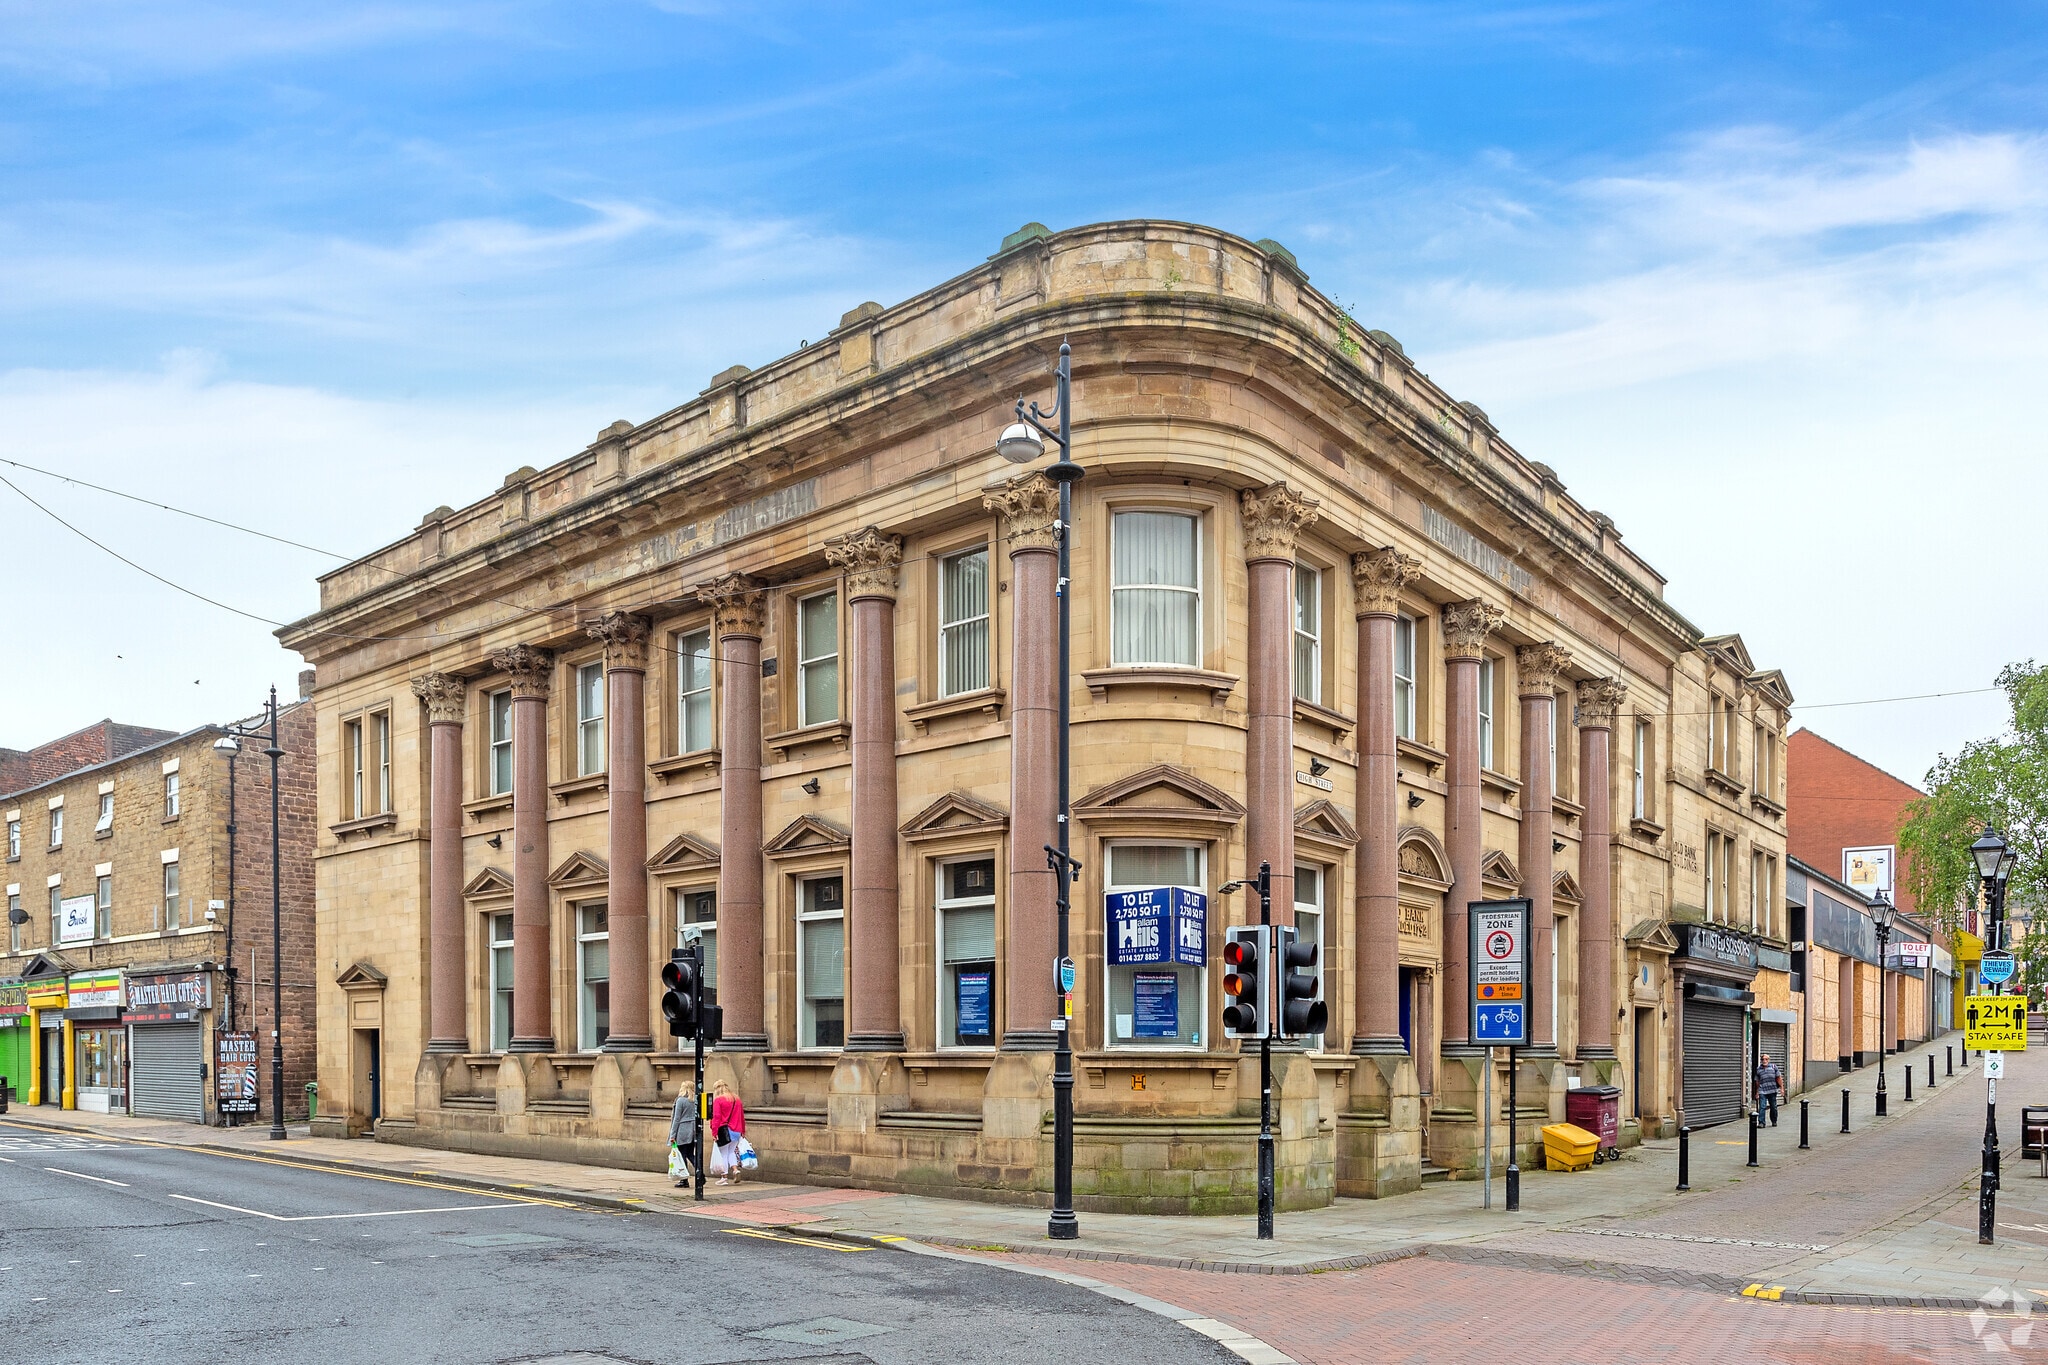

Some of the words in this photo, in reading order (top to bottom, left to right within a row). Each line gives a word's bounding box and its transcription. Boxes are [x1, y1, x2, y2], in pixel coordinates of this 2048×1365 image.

[1298, 773, 1313, 783] HIGH
[1315, 779, 1332, 790] STREET
[1122, 894, 1136, 907] TO
[1138, 892, 1154, 905] LET
[1183, 892, 1190, 905] TO
[1191, 894, 1200, 907] LET
[1115, 907, 1138, 920] 2,750
[1139, 906, 1151, 916] SQ
[1152, 905, 1161, 915] FT
[1180, 905, 1192, 917] 2,750
[1192, 908, 1199, 918] SQ
[1405, 908, 1423, 922] BANK
[1487, 920, 1513, 928] ZONE
[1725, 937, 1750, 958] SCISSORS
[134, 984, 160, 1005] MASTER
[160, 983, 177, 1003] HAIR
[177, 982, 194, 1002] CUTS
[1983, 1005, 2009, 1018] 2M
[1968, 1032, 1994, 1040] STAY
[1997, 1032, 2023, 1040] SAFE
[220, 1040, 256, 1052] MASTER
[220, 1053, 238, 1062] HAIR
[239, 1053, 256, 1062] CUTS
